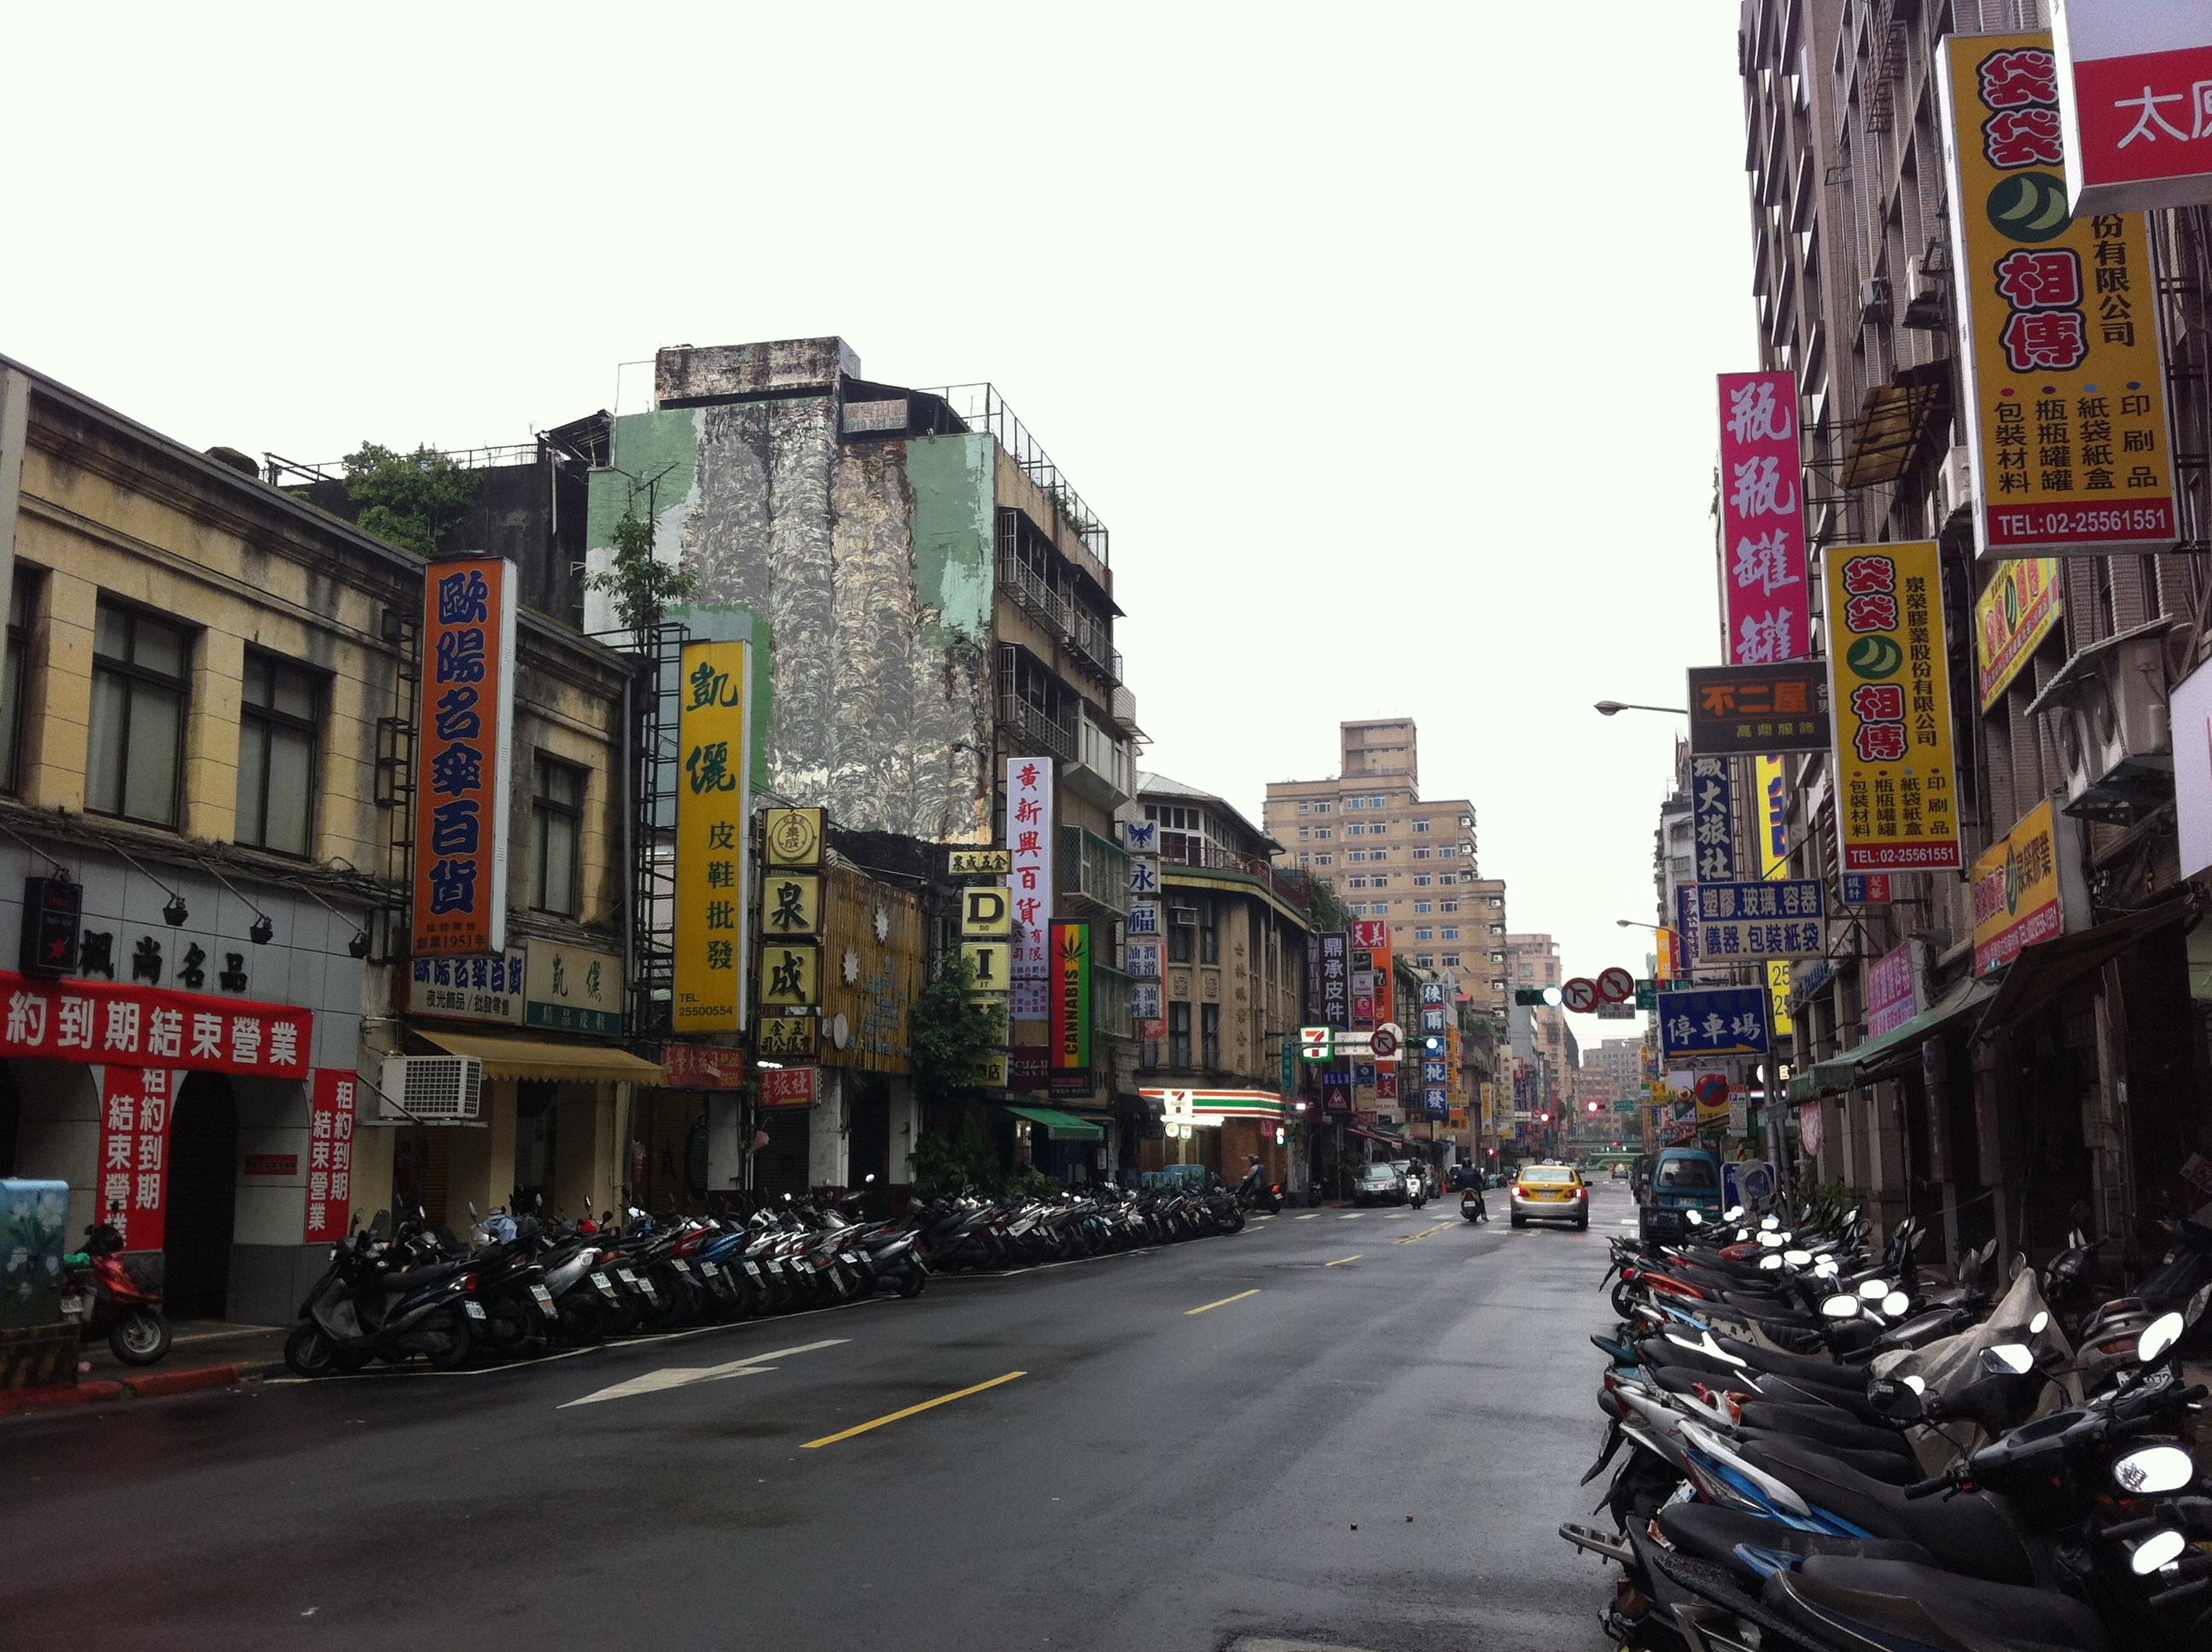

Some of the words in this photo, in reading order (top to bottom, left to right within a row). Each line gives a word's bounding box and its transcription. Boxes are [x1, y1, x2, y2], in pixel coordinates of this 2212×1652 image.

[1977, 49, 2064, 168] 袋袋
[1995, 248, 2087, 373] 相傳
[2091, 213, 2136, 348] 份有限公司
[1994, 401, 2031, 495] 包裝材料
[2034, 399, 2075, 492] 瓶瓶罐罐
[2077, 398, 2116, 490] 紙袋紙盒
[2120, 395, 2159, 488] 印刷品
[1726, 381, 1801, 665] 瓶瓶罐罐
[1997, 509, 2168, 538] TEL:02-25561551
[1843, 556, 1897, 632] 袋袋
[1701, 682, 1808, 717] 不二屋
[1904, 576, 1937, 747] 泉榮膠業股份有限公司
[428, 569, 490, 915] 歐陽名傘百貨
[1852, 683, 1909, 761] 相傳
[1014, 764, 1043, 927] 黃新興百貨
[1849, 779, 1871, 838] 包裝材料
[1875, 778, 1898, 837] 瓶瓶罐罐
[1901, 777, 1924, 836] 紙袋紙盒
[1927, 776, 1950, 835] 印刷品
[706, 821, 736, 970] 皮鞋批發
[952, 853, 1009, 872] 泉成五金
[1128, 863, 1155, 932] 永福
[1850, 846, 1954, 866] TEL:02-25561551
[770, 881, 810, 1002] 泉成
[1324, 937, 1344, 1021] 鼎承皮件
[6, 990, 298, 1067] 約到期結束營業
[678, 1005, 733, 1017] 25500554
[1065, 969, 1079, 1055] CANNABIS
[1667, 1012, 1761, 1045] 停車場
[136, 1067, 166, 1210] 租約到期
[308, 1110, 331, 1231] 結束營業
[330, 1080, 354, 1202] 租約到期
